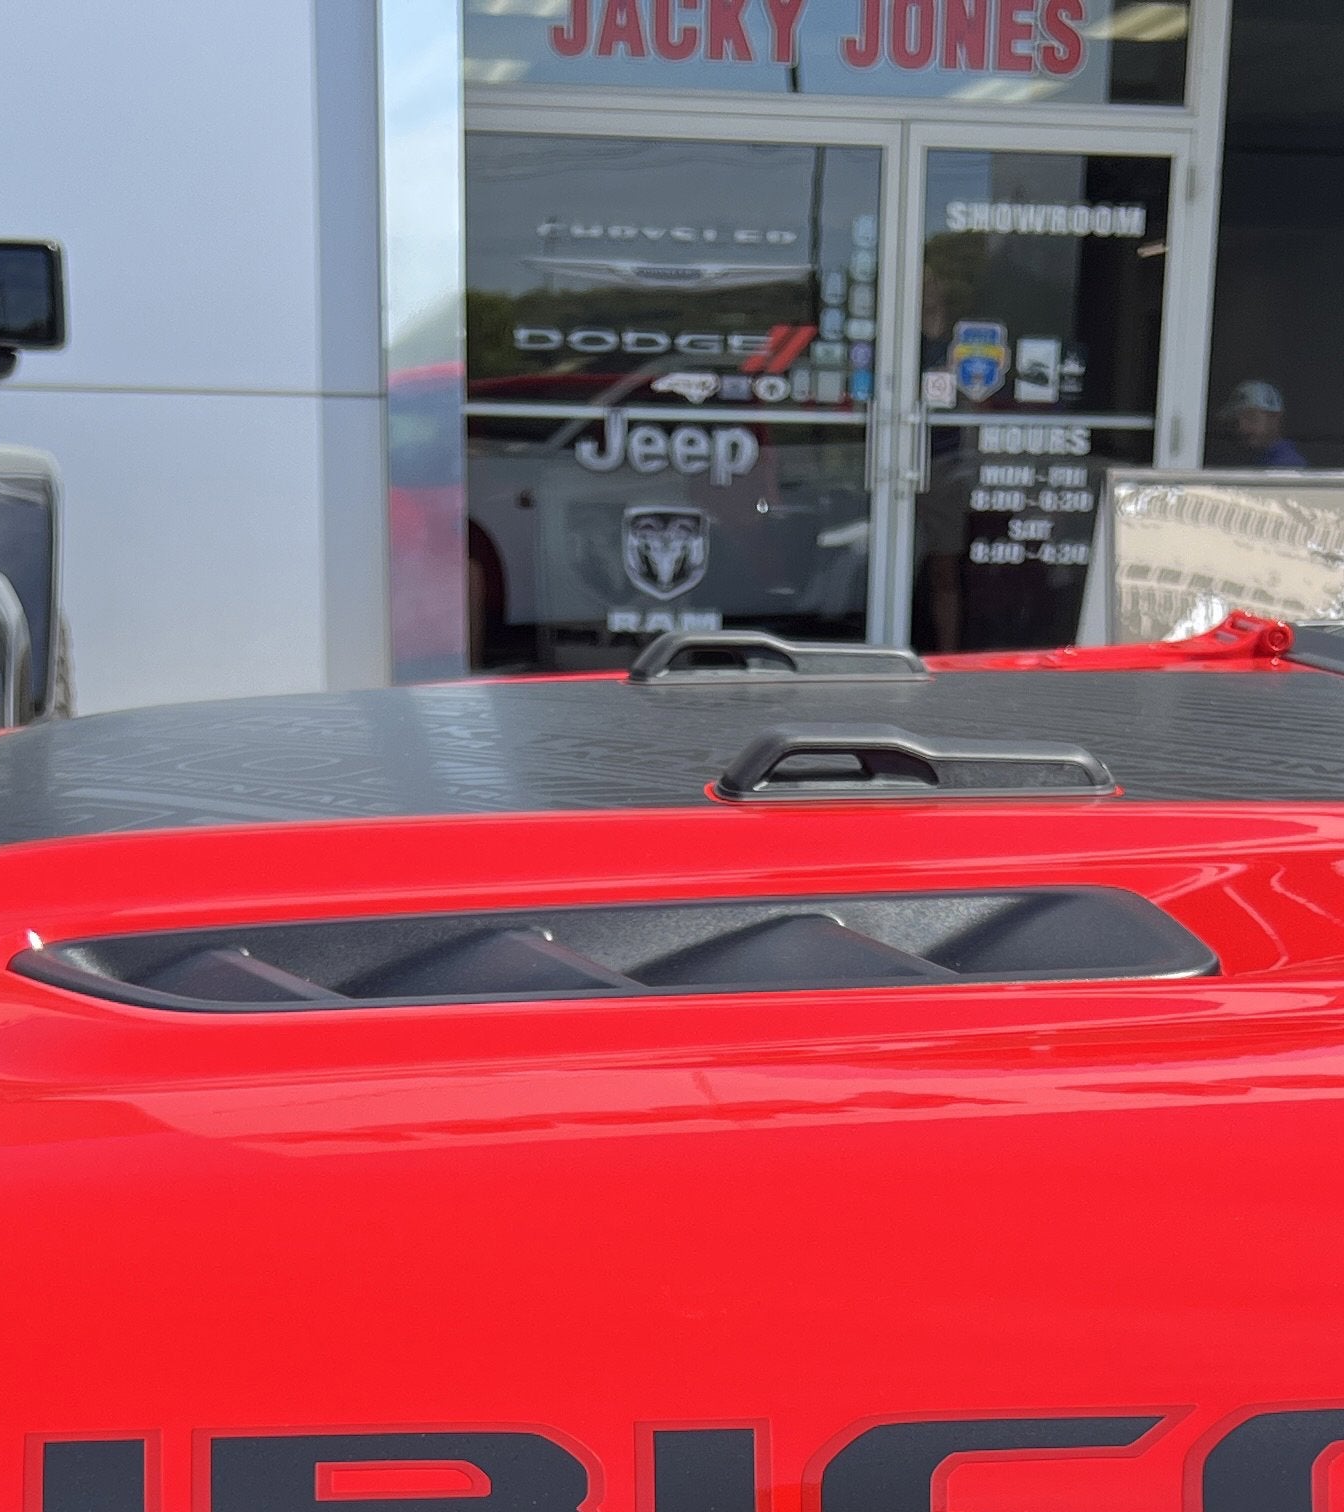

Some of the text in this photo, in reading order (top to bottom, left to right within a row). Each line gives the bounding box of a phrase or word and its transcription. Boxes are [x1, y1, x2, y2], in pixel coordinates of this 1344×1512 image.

[550, 0, 1085, 75] JACKY JONES
[946, 201, 1146, 238] SHOWROOM
[513, 328, 775, 354] DODGE
[574, 409, 759, 486] Jeep
